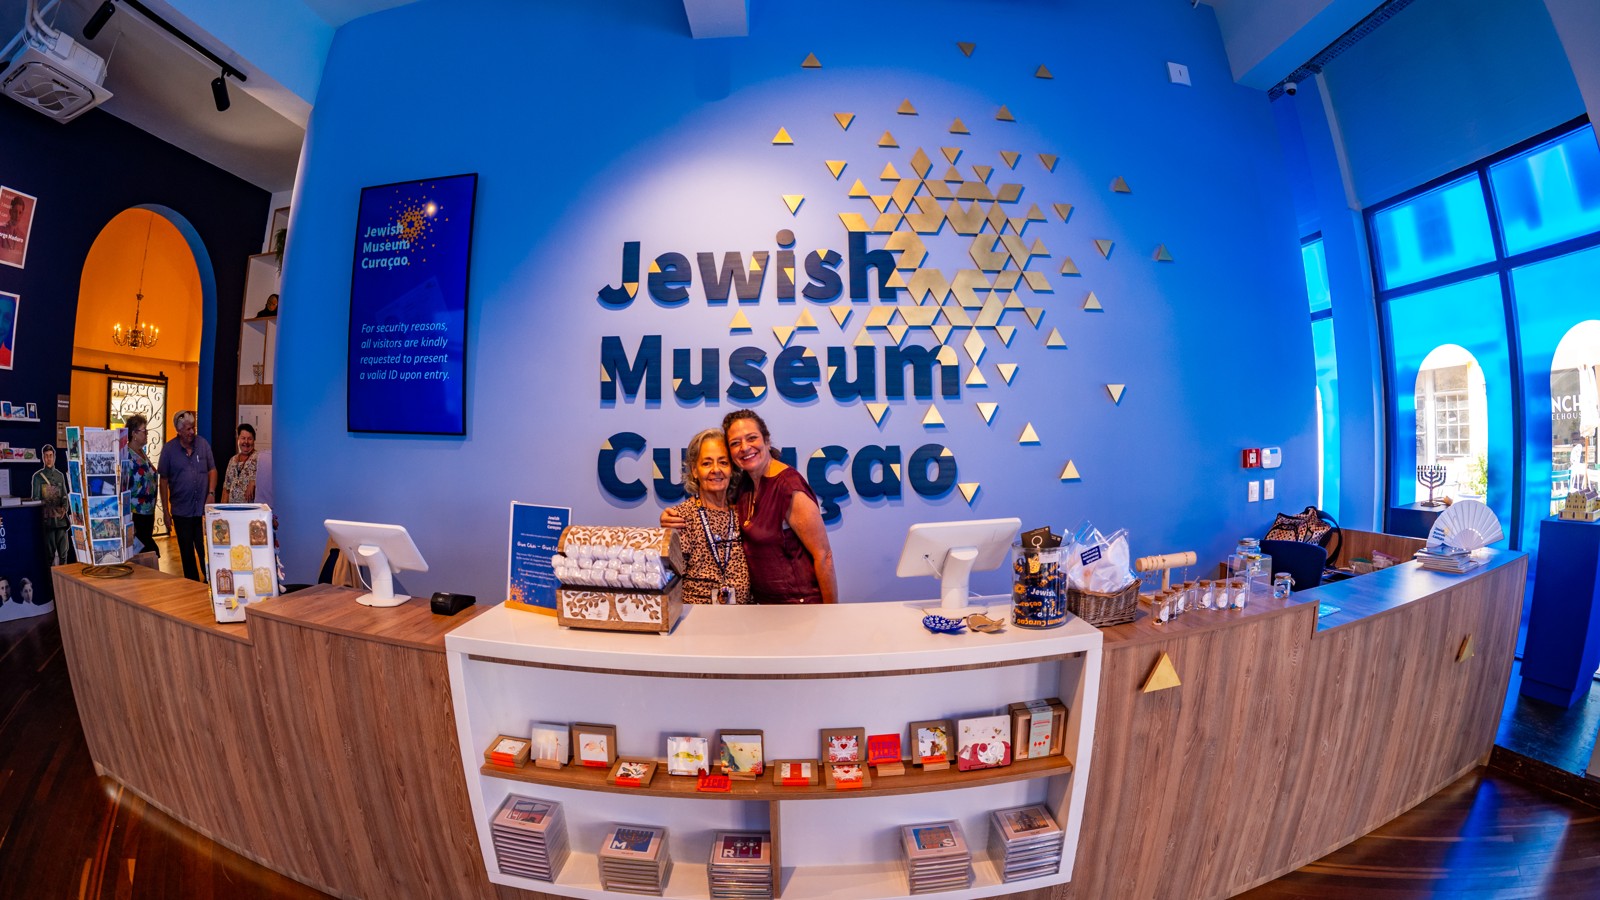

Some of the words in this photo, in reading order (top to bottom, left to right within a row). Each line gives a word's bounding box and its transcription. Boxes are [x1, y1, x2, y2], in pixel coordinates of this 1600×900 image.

[364, 222, 404, 238] Jewish
[362, 239, 411, 254] Museum
[598, 229, 898, 305] Jewish
[361, 323, 375, 333] For
[376, 321, 409, 334] security
[411, 322, 448, 332] reasons,
[361, 338, 372, 349] all
[373, 337, 402, 349] visitors
[404, 339, 419, 348] are
[421, 336, 448, 348] kindly
[360, 353, 401, 366] requested
[403, 355, 412, 364] to
[413, 353, 448, 365] present
[601, 334, 960, 401] Museum
[360, 372, 365, 380] a
[367, 369, 387, 380] valid
[388, 369, 398, 380] ID
[400, 371, 422, 382] upon
[424, 369, 450, 382] entry.
[598, 432, 957, 523] Cuçao
[1030, 587, 1057, 597] Jewish
[1016, 617, 1047, 627] Curaçao
[611, 840, 627, 850] M
[723, 848, 735, 858] R
